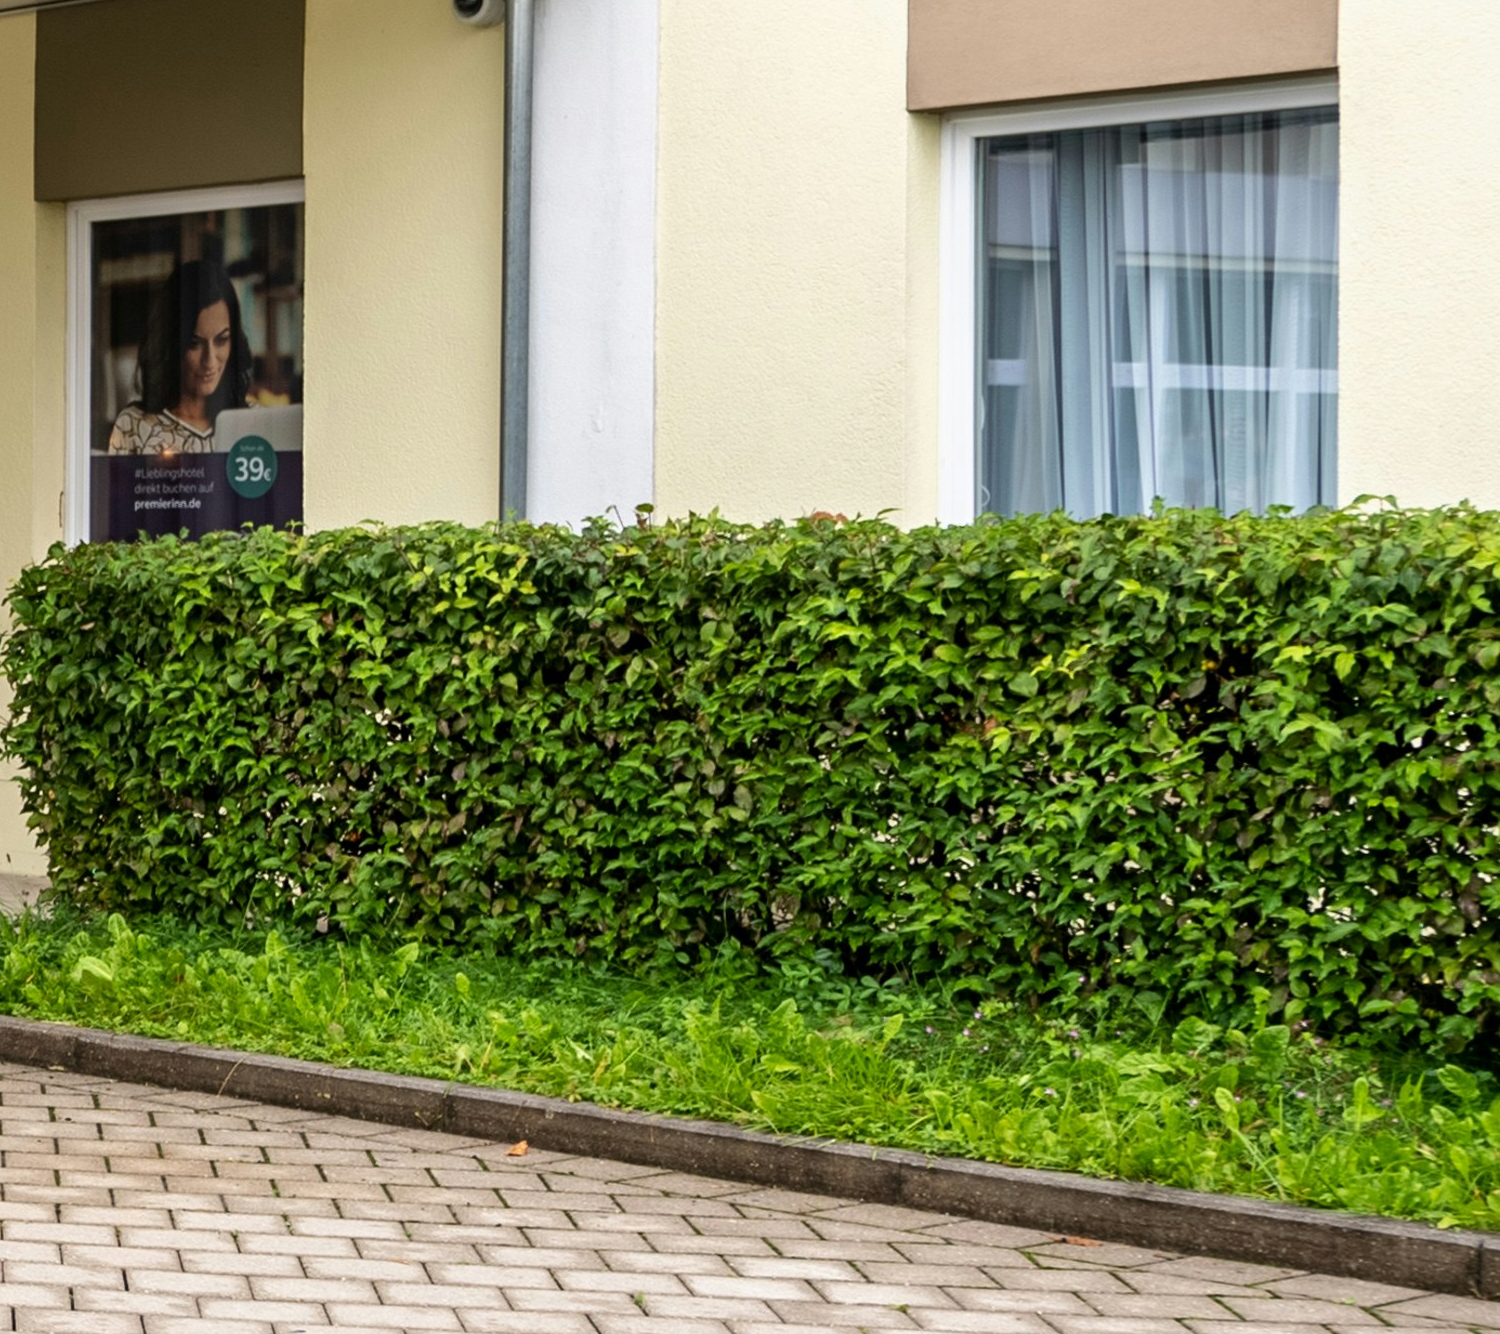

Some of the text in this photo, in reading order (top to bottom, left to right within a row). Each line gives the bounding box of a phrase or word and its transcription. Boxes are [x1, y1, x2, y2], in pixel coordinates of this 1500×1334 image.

[134, 467, 205, 481] #Lieblingshotel
[234, 456, 272, 482] 39€
[134, 482, 215, 495] direkt buchen auf
[134, 498, 201, 512] premierinn.de
